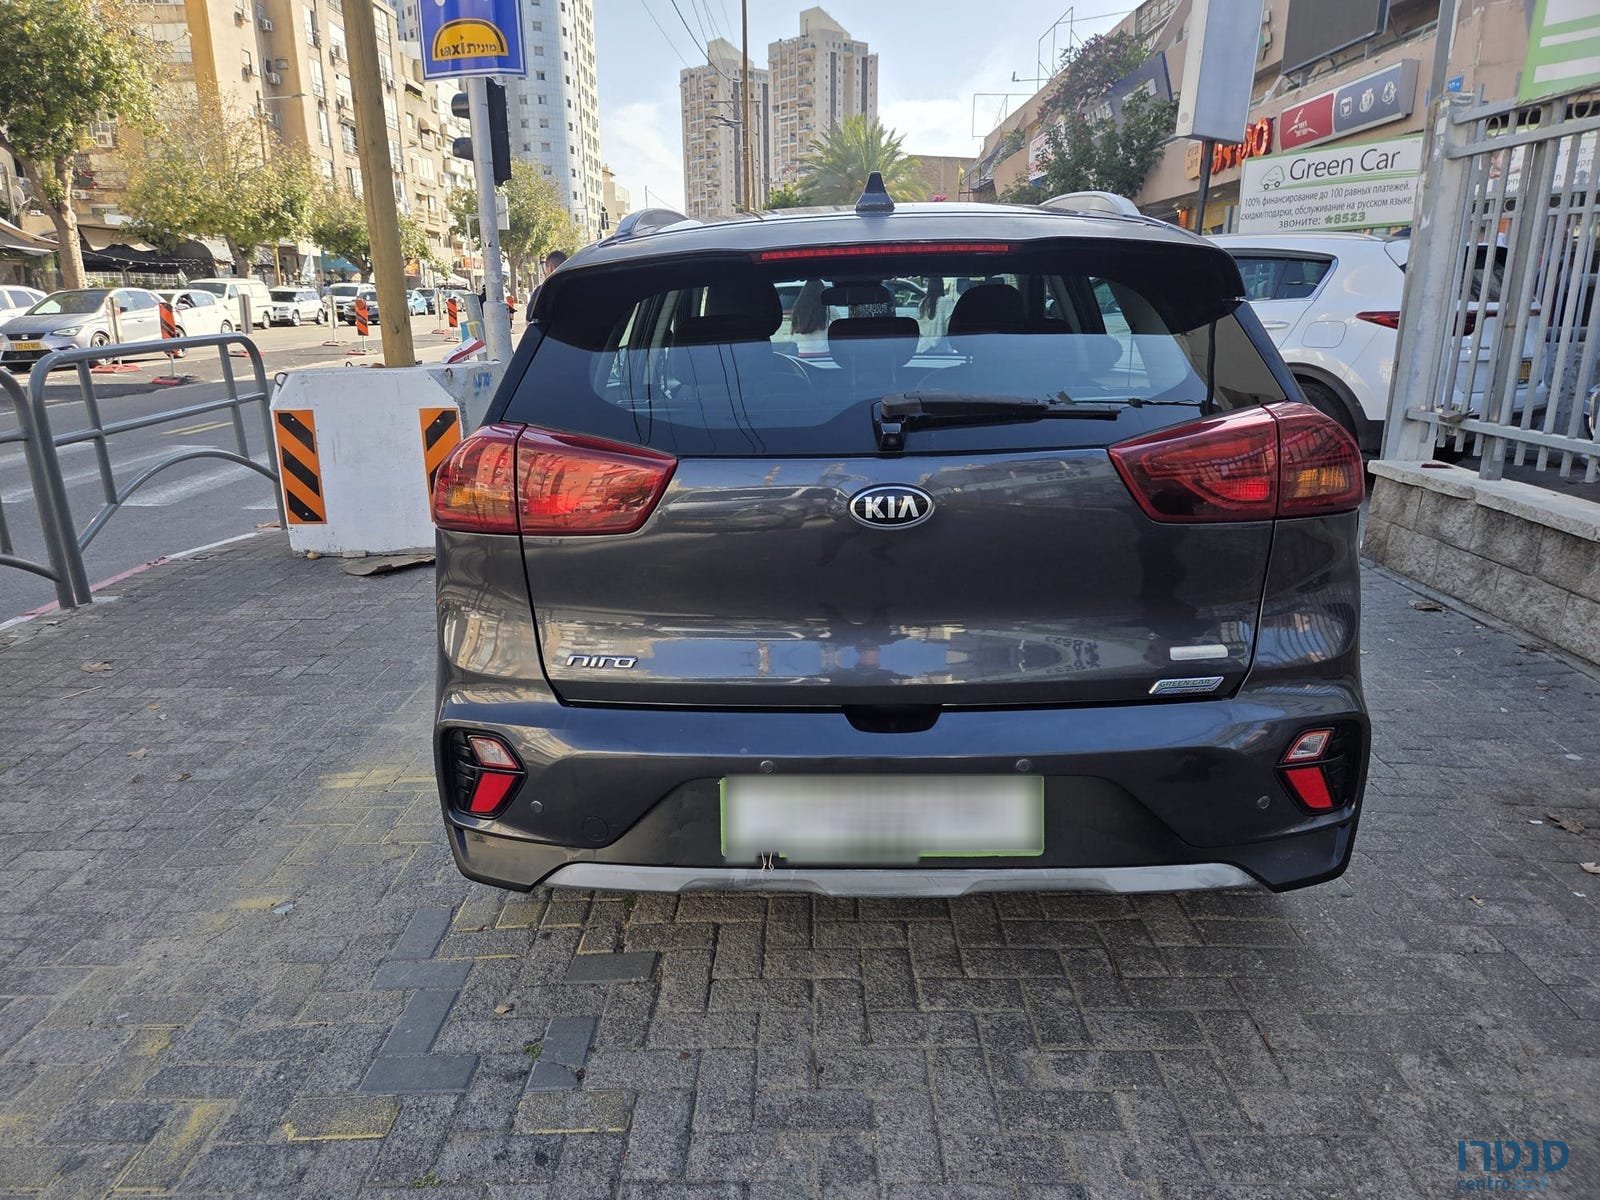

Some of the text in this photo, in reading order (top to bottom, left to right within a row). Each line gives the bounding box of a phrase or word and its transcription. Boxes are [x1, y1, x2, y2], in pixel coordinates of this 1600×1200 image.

[440, 35, 465, 57] taxi
[466, 42, 497, 54] מונית
[1290, 149, 1400, 180] Green Car
[1245, 197, 1261, 208] 100%
[1262, 191, 1318, 207] финансирование
[1318, 191, 1329, 201] до
[1331, 187, 1343, 199] 100
[1344, 186, 1371, 198] равных
[1294, 202, 1345, 217] обслуживание
[1346, 202, 1355, 210] на
[1357, 198, 1388, 212] русском
[1278, 217, 1321, 229] звоните:
[864, 495, 919, 519] KIA
[566, 654, 638, 669] niro
[1159, 680, 1190, 688] GREEN
